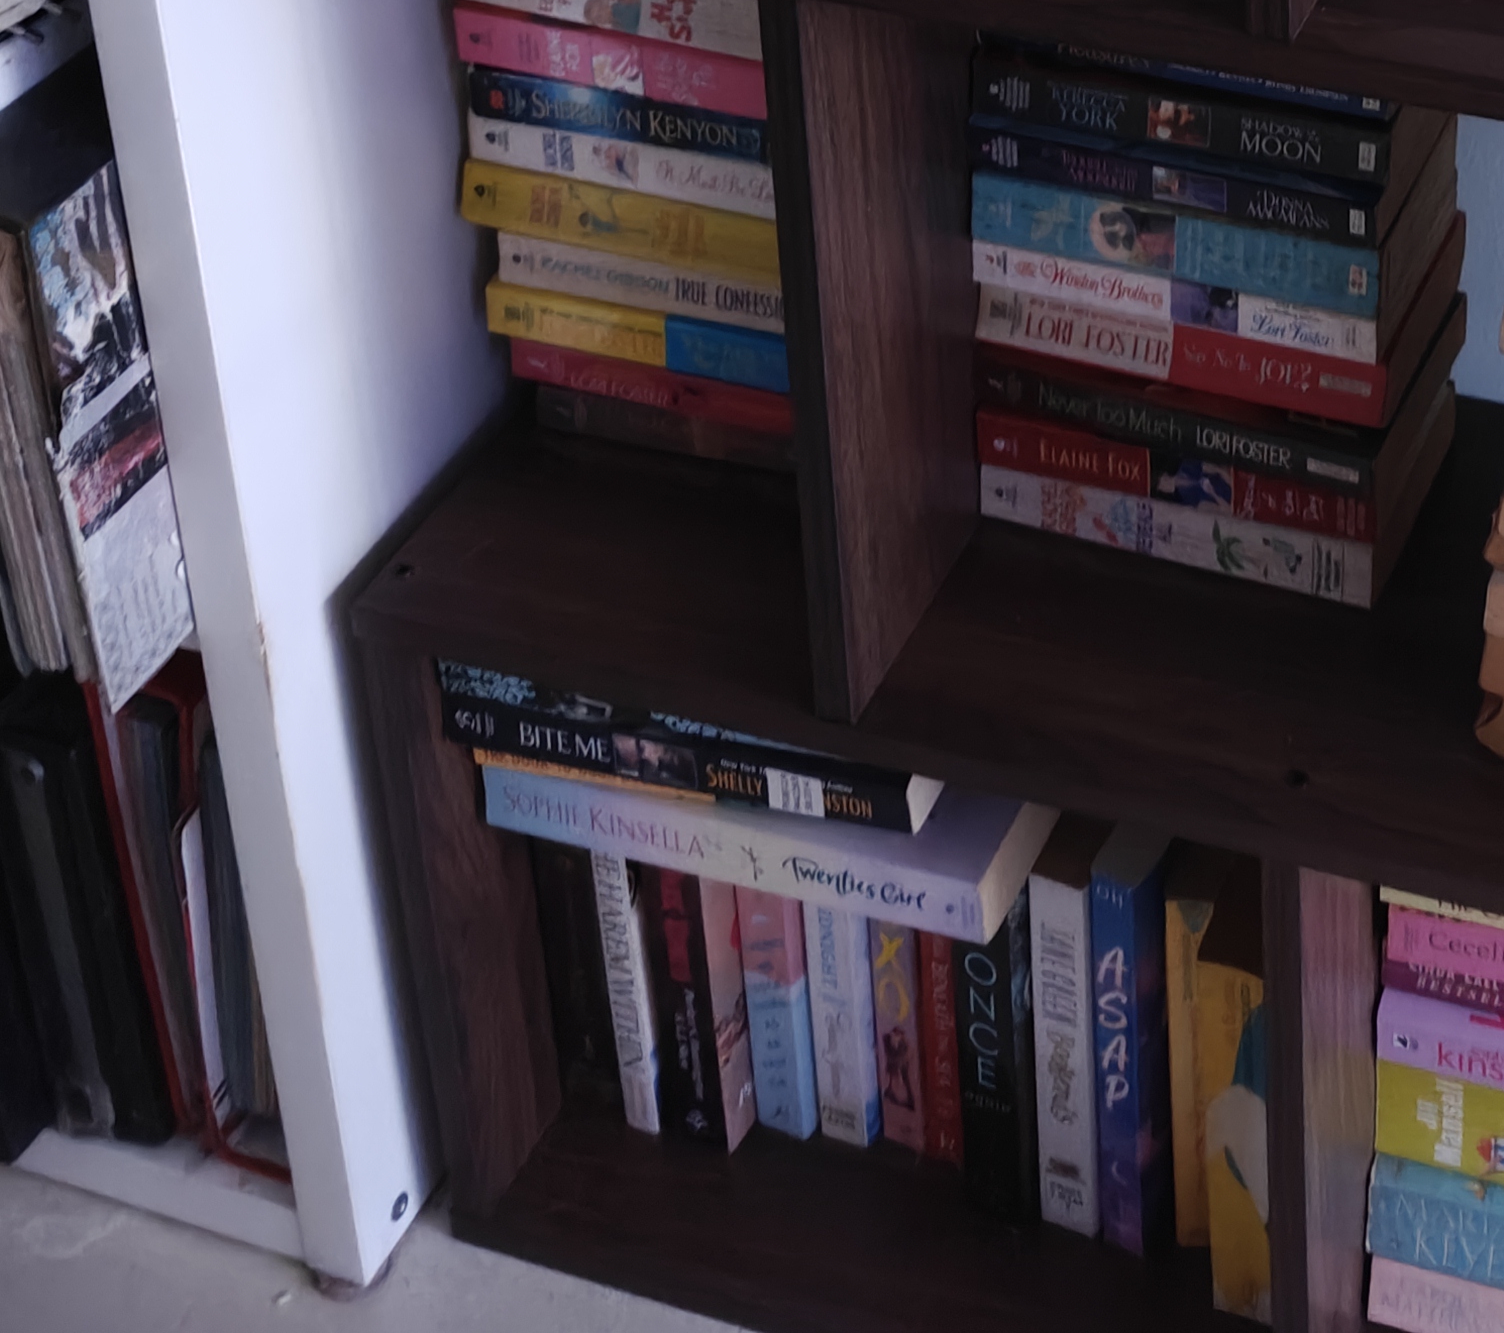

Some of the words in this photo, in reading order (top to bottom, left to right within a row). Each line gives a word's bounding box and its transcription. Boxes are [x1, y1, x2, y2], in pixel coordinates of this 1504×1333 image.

[650, 109, 739, 146] KENYON
[1059, 101, 1119, 131] YORK
[1240, 117, 1303, 138] SHADOW
[1240, 131, 1322, 166] MOON
[674, 276, 708, 307] TRUE
[1101, 273, 1164, 310] Brothers
[1024, 311, 1075, 347] LORI
[1085, 324, 1170, 367] FOSTER
[1251, 312, 1286, 338] Lori
[1288, 321, 1335, 348] Foster
[1038, 382, 1089, 418] Never
[1097, 398, 1127, 428] Too
[1130, 406, 1183, 444] Much
[1039, 437, 1100, 473] ELAINE
[1107, 450, 1143, 482] FOX
[1196, 424, 1231, 455] LORI
[1232, 435, 1293, 471] FOSTER
[519, 720, 572, 756] BITE
[574, 733, 612, 764] ME
[706, 762, 763, 798] SHELLY
[502, 785, 578, 827] SOPHIE
[589, 806, 706, 860] KINSELLA
[782, 856, 876, 901] Twenties
[963, 951, 999, 1089] ONCE
[1097, 946, 1130, 1111] ASAP
